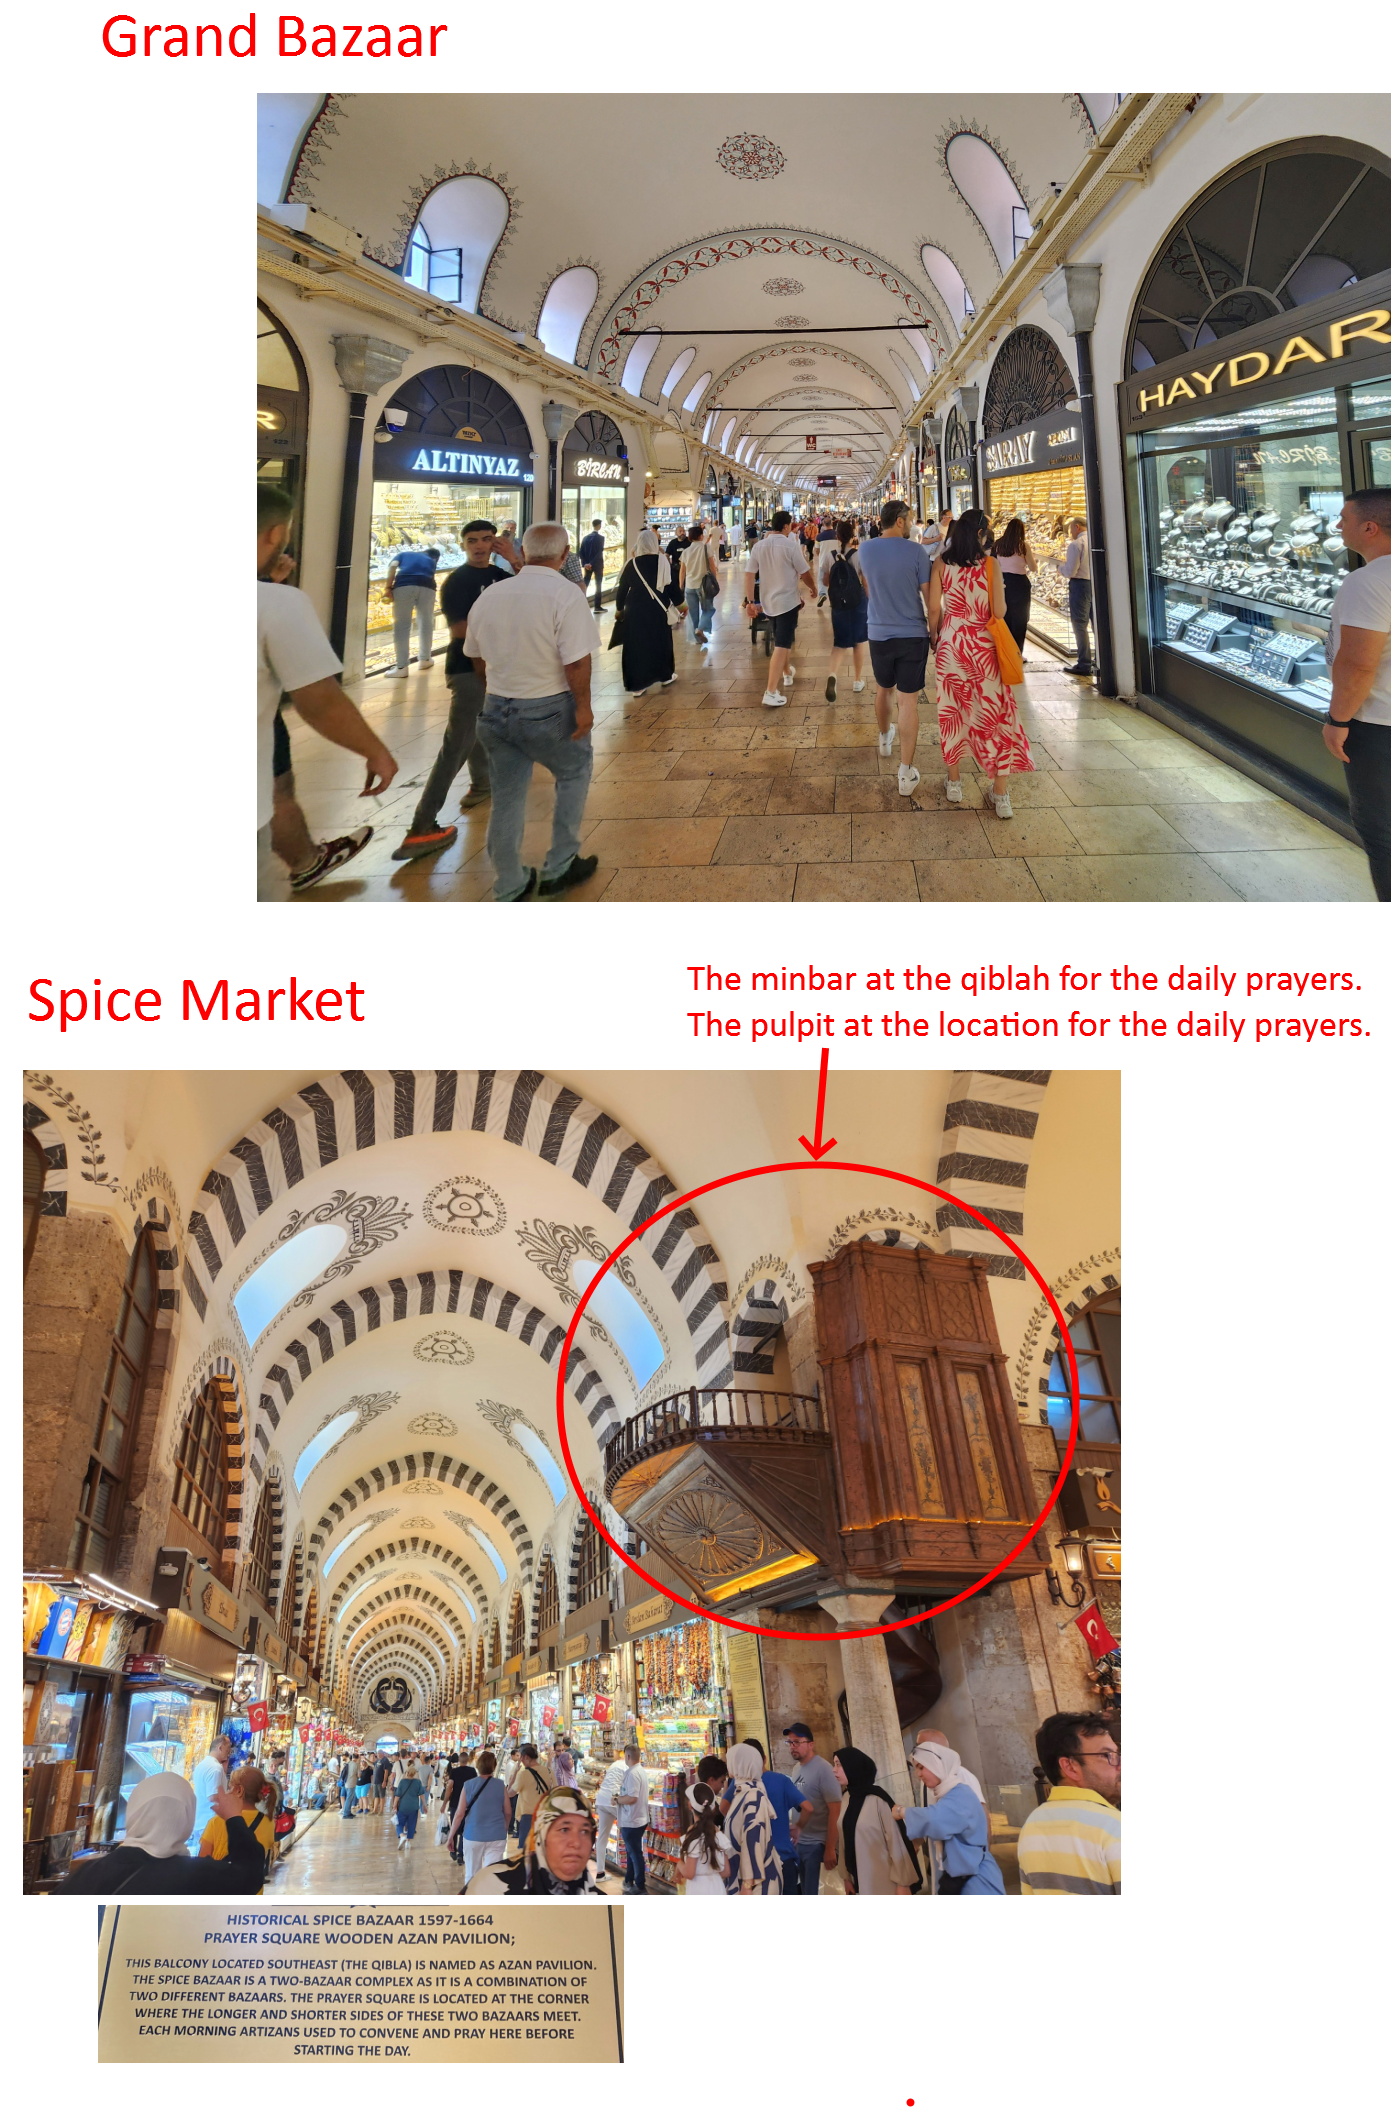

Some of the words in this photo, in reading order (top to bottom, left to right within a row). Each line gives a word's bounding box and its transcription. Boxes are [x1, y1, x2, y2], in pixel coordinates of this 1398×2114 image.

[1139, 309, 1391, 413] HAYDAR
[986, 430, 1036, 472] SARAY
[412, 448, 520, 477] ALTINYAZ
[226, 1914, 310, 1926] HISTORICAL
[312, 1914, 352, 1926] SPICE
[356, 1914, 415, 1926] BAZAAR
[418, 1914, 494, 1926] 1597-1664
[204, 1932, 258, 1944] PRAYER
[261, 1932, 321, 1946] SQUARE
[324, 1932, 394, 1945] WOODEN
[397, 1932, 438, 1945] AZAN
[442, 1932, 516, 1947] PAVILION;
[125, 1958, 151, 1969] THIS
[153, 1958, 210, 1969] BALCONY
[211, 1958, 265, 1969] LOCATED
[266, 1959, 339, 1970] SOUTHEAST
[340, 1959, 369, 1973] (THE
[371, 1959, 412, 1973] QIBLA)
[415, 1959, 426, 1971] IS
[429, 1959, 477, 1971] NAMED
[478, 1959, 496, 1971] AS
[497, 1959, 533, 1971] AZAN
[535, 1959, 597, 1971] PAVILION.
[132, 1974, 156, 1985] THE
[157, 1974, 191, 1985] SPICE
[192, 1974, 242, 1986] BAZAAR
[244, 1975, 255, 1986] IS
[257, 1975, 267, 1986] A
[269, 1975, 352, 1987] TWO-BAZAAR
[354, 1976, 414, 1988] COMPLEX
[416, 1976, 433, 1988] AS
[435, 1976, 448, 1987] IT
[449, 1976, 461, 1988] IS
[463, 1976, 474, 1988] A
[475, 1976, 568, 1988] COMBINATION
[570, 1976, 588, 1987] OF
[129, 1991, 159, 2002] TWO
[160, 1991, 226, 2003] DIFFERENT
[228, 1991, 287, 2003] BAZAARS.
[290, 1992, 314, 2004] THE
[316, 1992, 363, 2004] PRAYER
[365, 1993, 416, 2006] SQUARE
[418, 1993, 430, 2005] IS
[433, 1993, 489, 2005] LOCATED
[490, 1993, 507, 2005] AT
[509, 1993, 534, 2005] THE
[537, 1993, 590, 2005] CORNER
[134, 2007, 179, 2019] WHERE
[181, 2008, 205, 2019] THE
[207, 2008, 257, 2020] LONGER
[259, 2009, 288, 2020] AND
[290, 2009, 347, 2021] SHORTER
[349, 2010, 384, 2022] SIDES
[386, 2010, 404, 2022] OF
[406, 2010, 445, 2022] THESE
[447, 2010, 479, 2022] TWO
[481, 2010, 540, 2022] BAZAARS
[543, 2010, 582, 2022] MEET.
[138, 2024, 172, 2036] EACH
[173, 2025, 237, 2037] MORNING
[239, 2026, 301, 2038] ARTIZANS
[303, 2026, 337, 2038] USED
[338, 2027, 357, 2039] TO
[358, 2027, 420, 2039] CONVENE
[421, 2027, 451, 2039] AND
[453, 2028, 487, 2040] PRAY
[489, 2028, 523, 2040] HERE
[525, 2028, 575, 2040] BEFORE
[293, 2044, 354, 2057] STARTING
[357, 2045, 382, 2057] THE
[384, 2045, 411, 2057] DAY.
